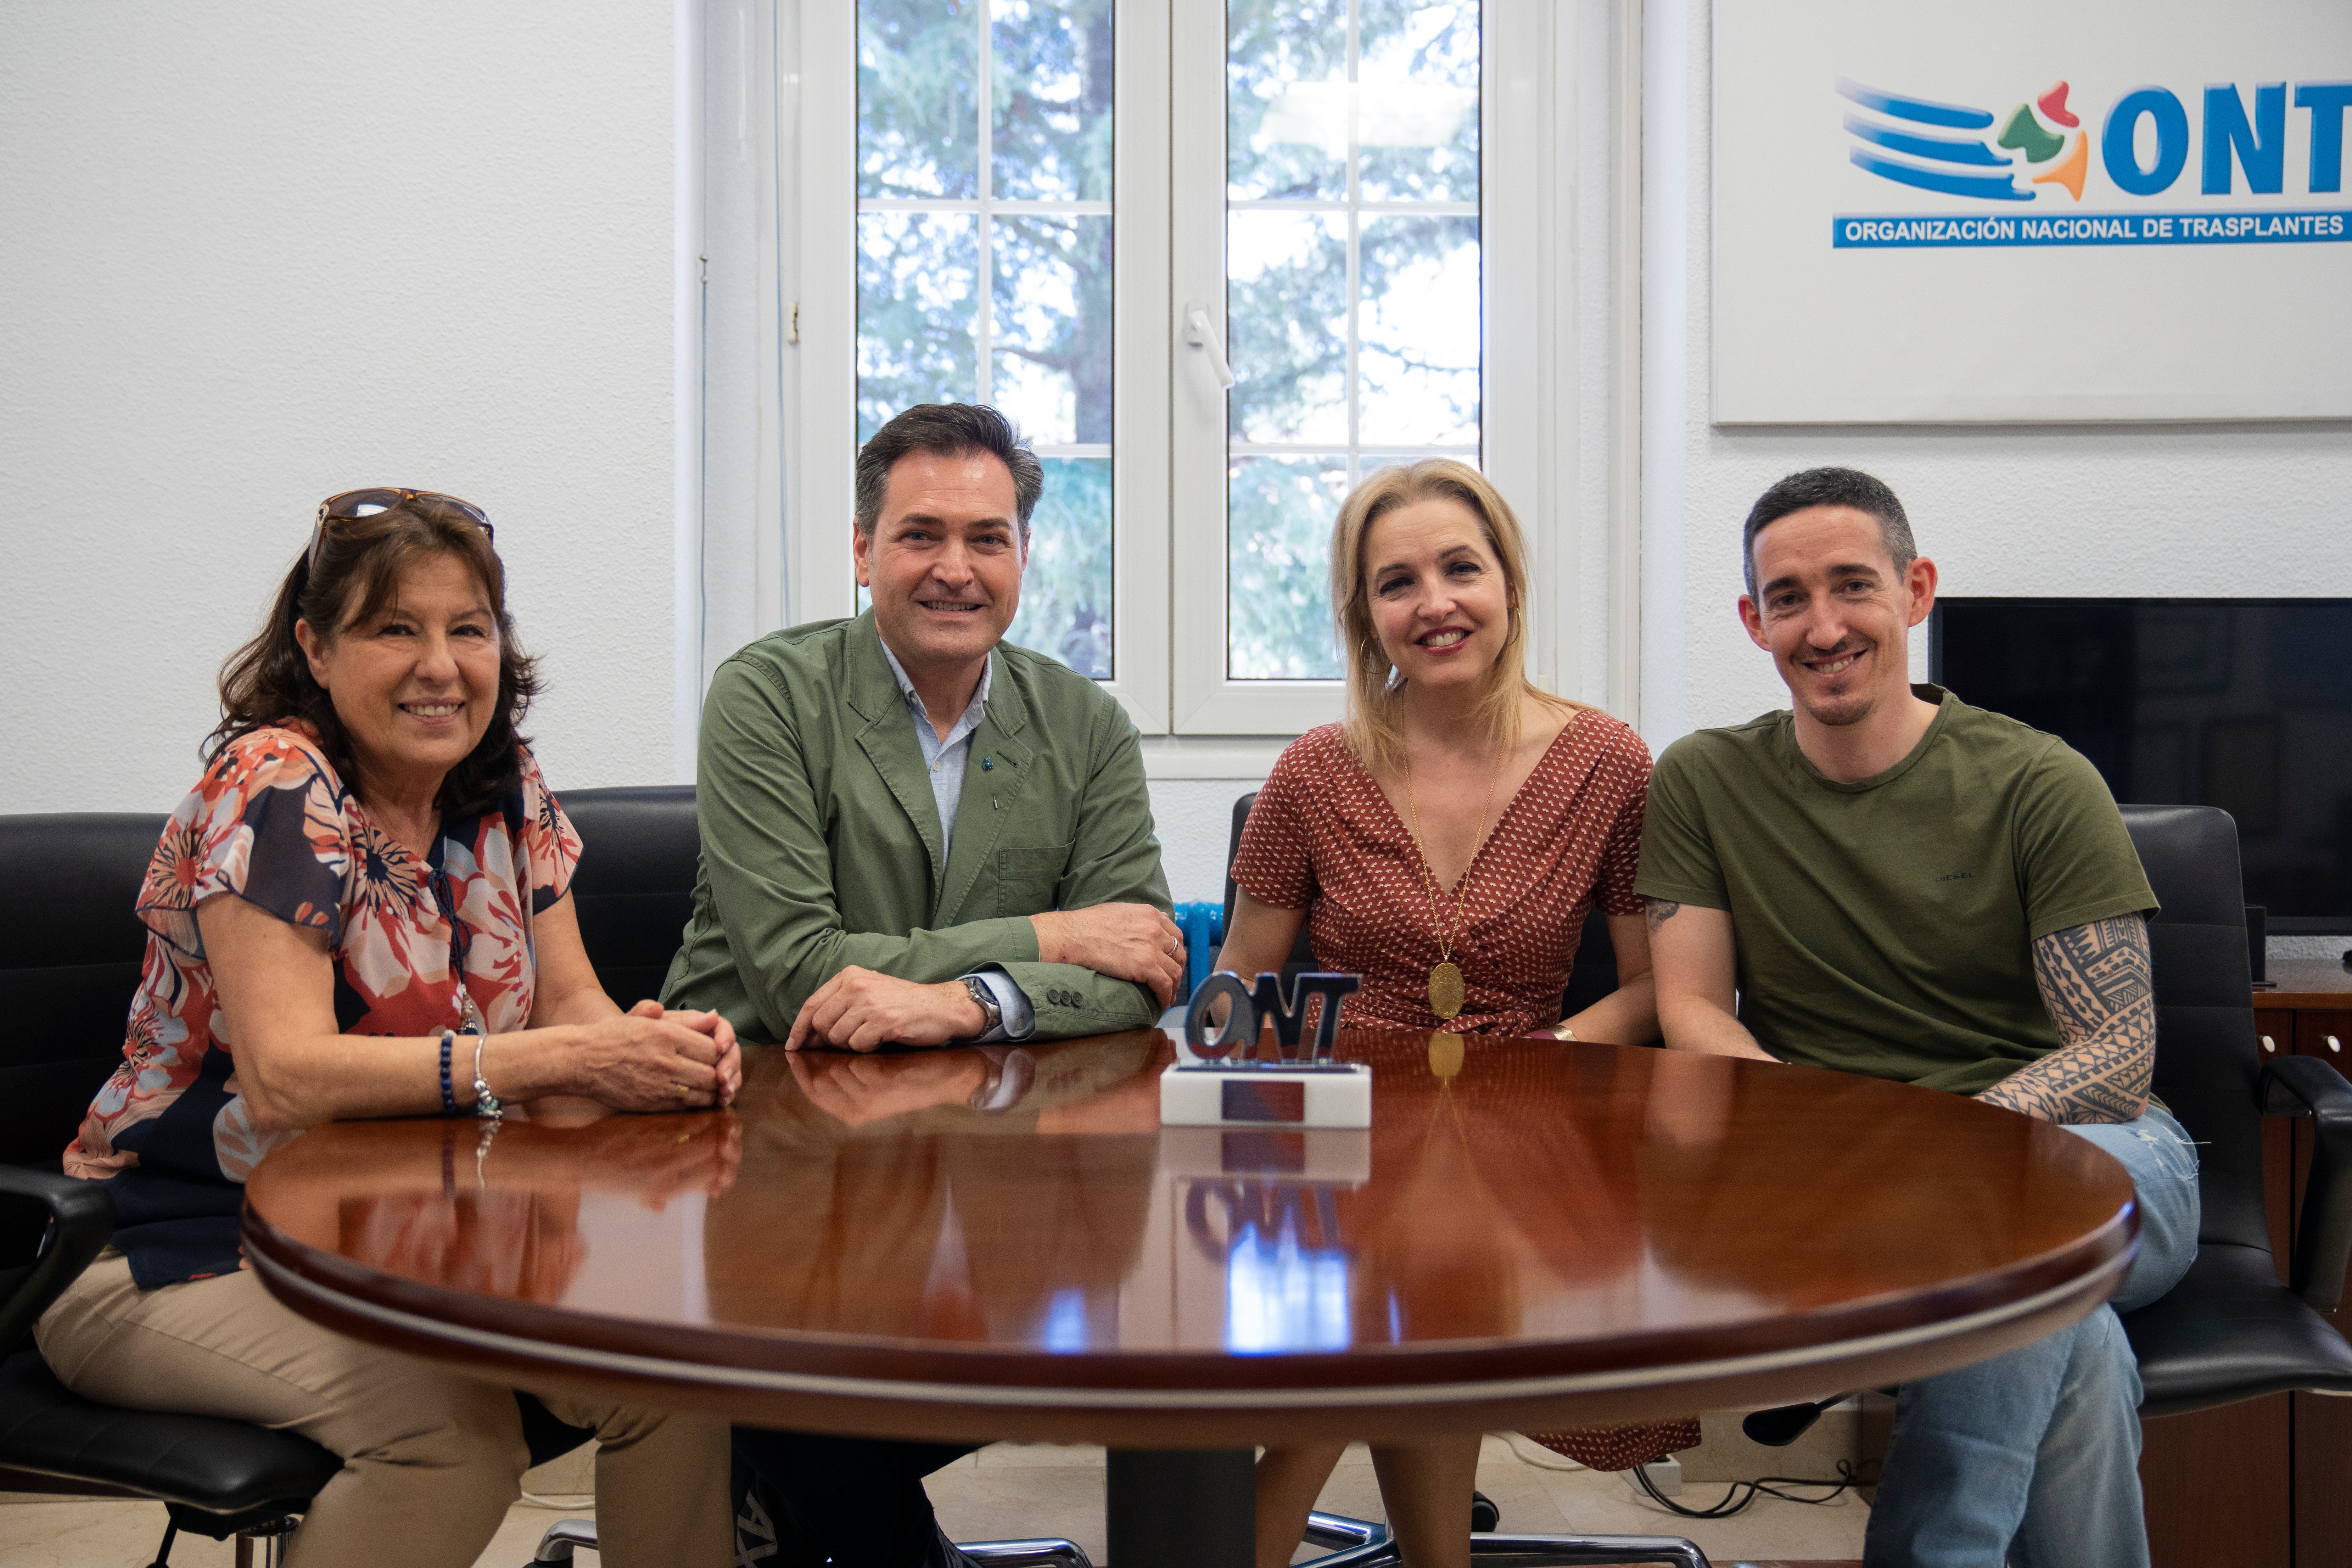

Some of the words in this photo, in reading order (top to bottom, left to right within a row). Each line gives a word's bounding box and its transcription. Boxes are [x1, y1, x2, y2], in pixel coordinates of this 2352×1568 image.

[2102, 81, 2352, 197] ONT
[1846, 216, 2015, 241] ORGANIZACIÓN
[2022, 219, 2137, 239] NACIONAL
[2143, 218, 2173, 238] DE
[2179, 215, 2344, 237] TRASPLANTES
[1935, 872, 1976, 882] DIESEL
[1185, 970, 1363, 1061] ONT
